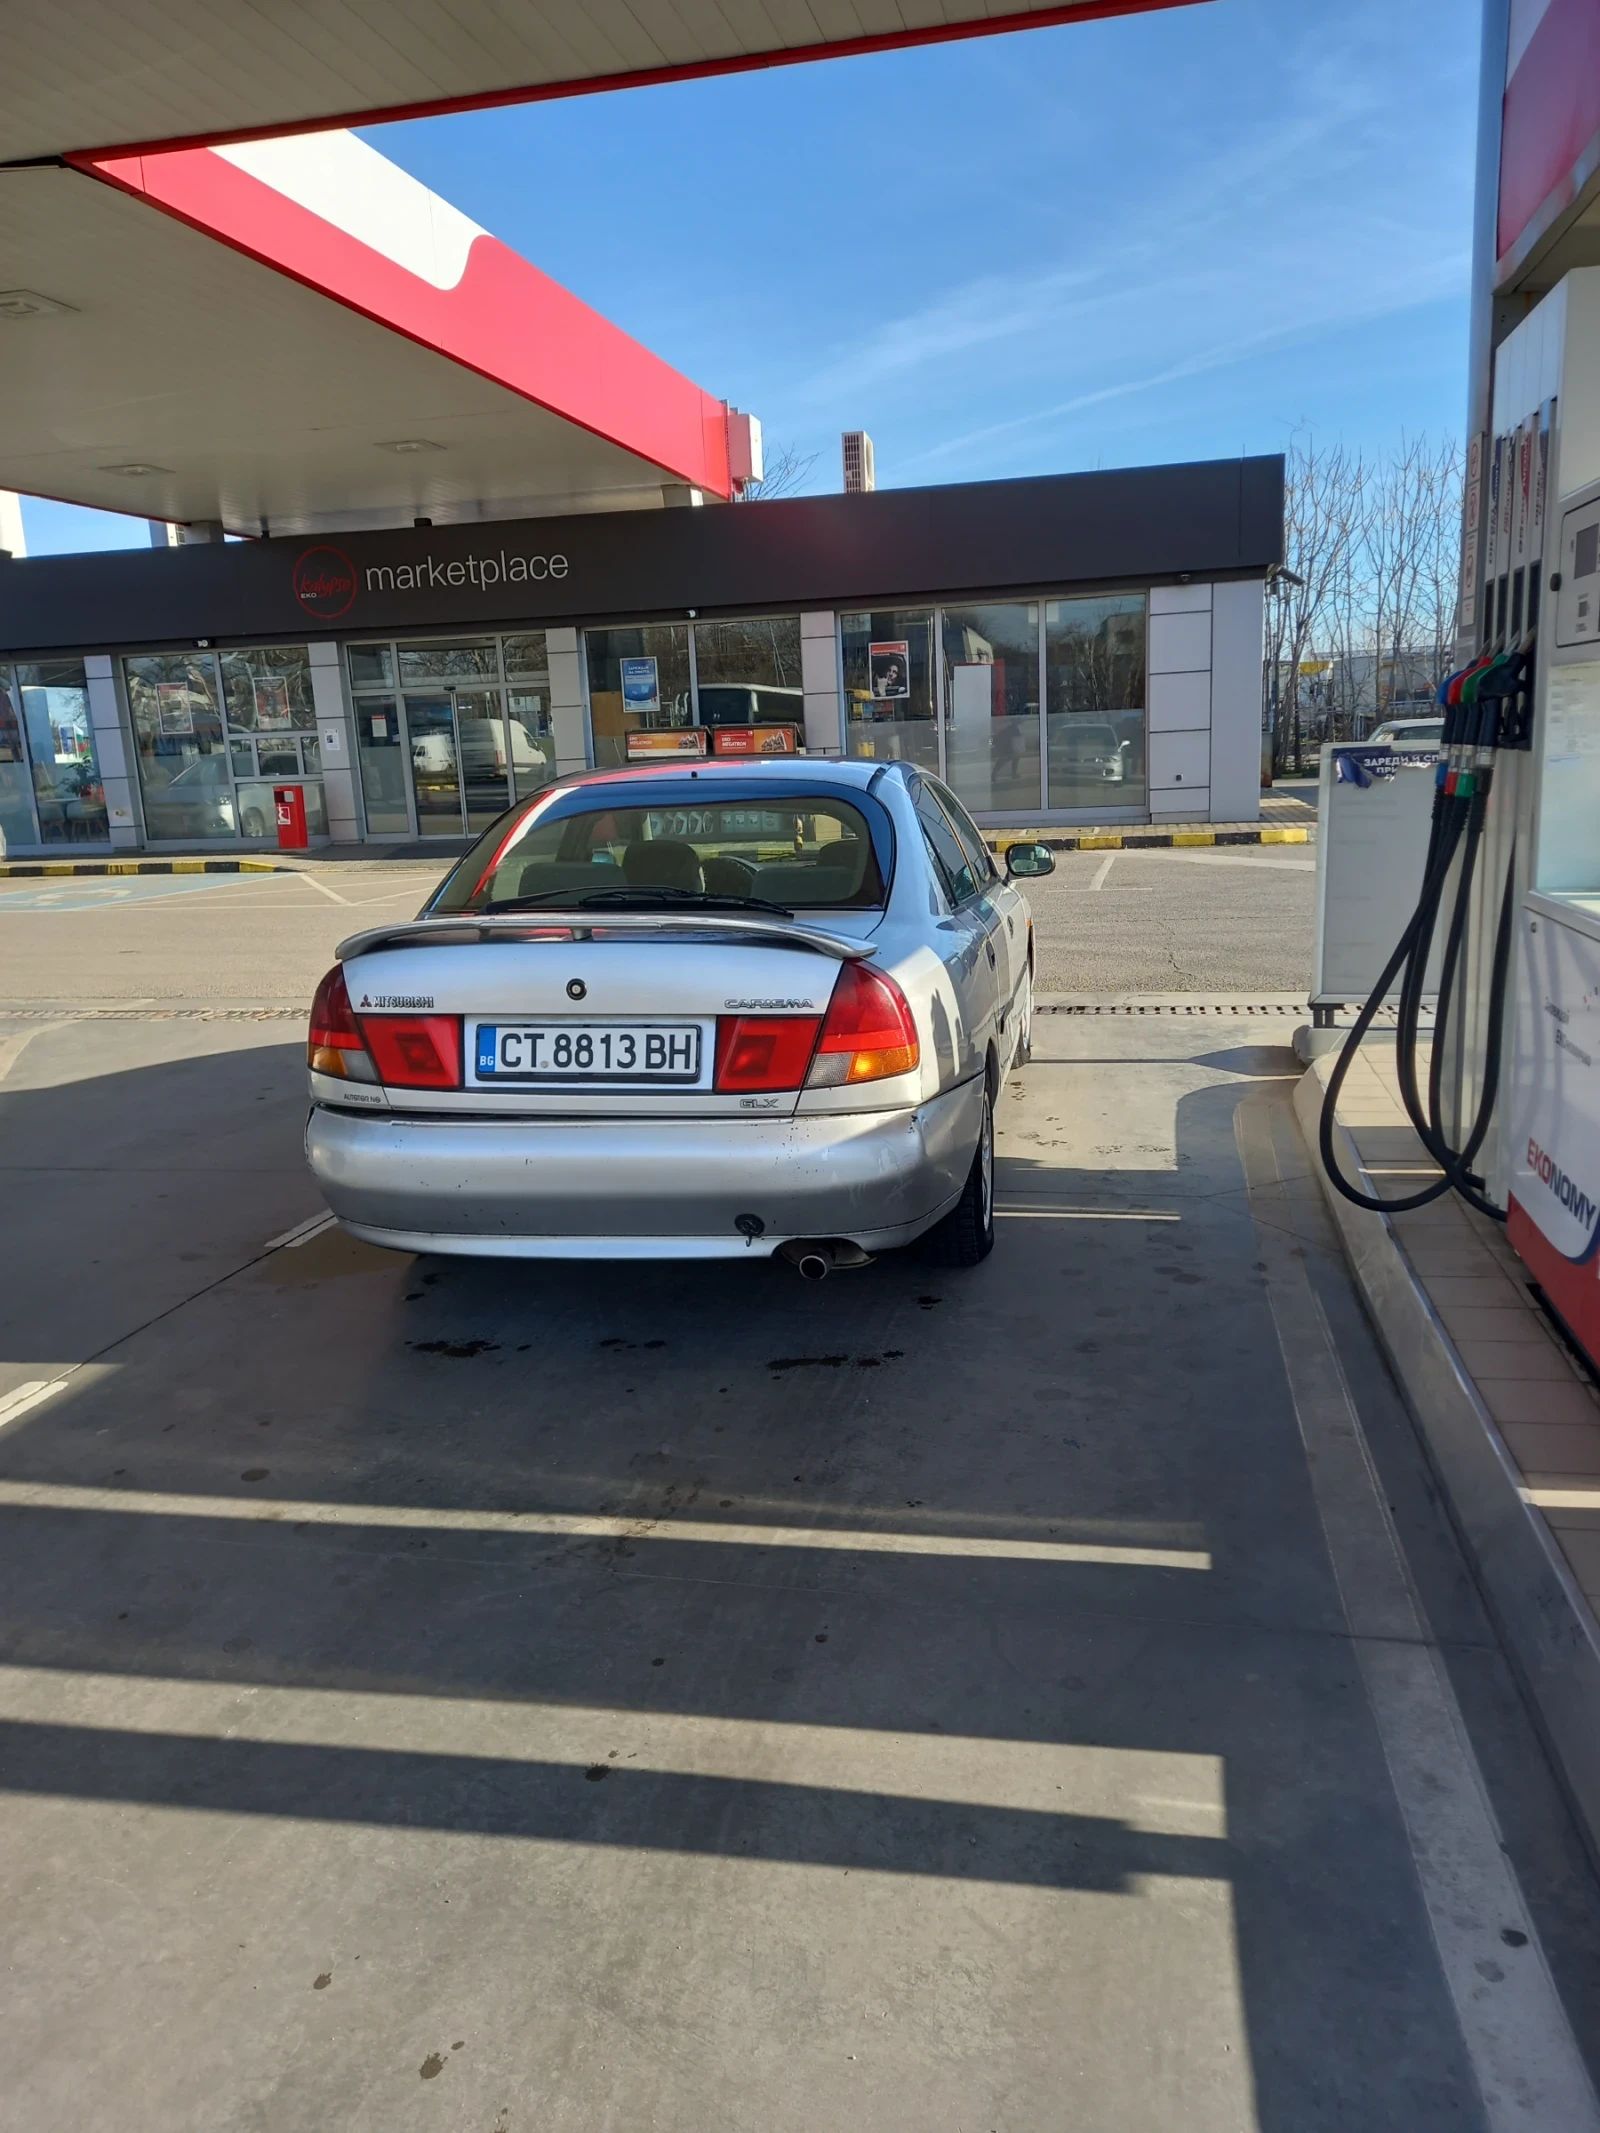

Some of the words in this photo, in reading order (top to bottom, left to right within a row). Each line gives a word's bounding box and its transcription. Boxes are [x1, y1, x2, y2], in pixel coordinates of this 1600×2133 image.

[365, 550, 569, 592] marketplace
[299, 572, 352, 600] kalypso
[373, 995, 434, 1008] MITSUBISHI
[724, 998, 815, 1009] CARISMA
[480, 1055, 494, 1067] BG
[500, 1032, 545, 1069] CT
[553, 1033, 637, 1070] 8813
[645, 1033, 691, 1070] BH
[739, 1098, 779, 1109] GLX
[1526, 1137, 1597, 1231] EKONOMY
